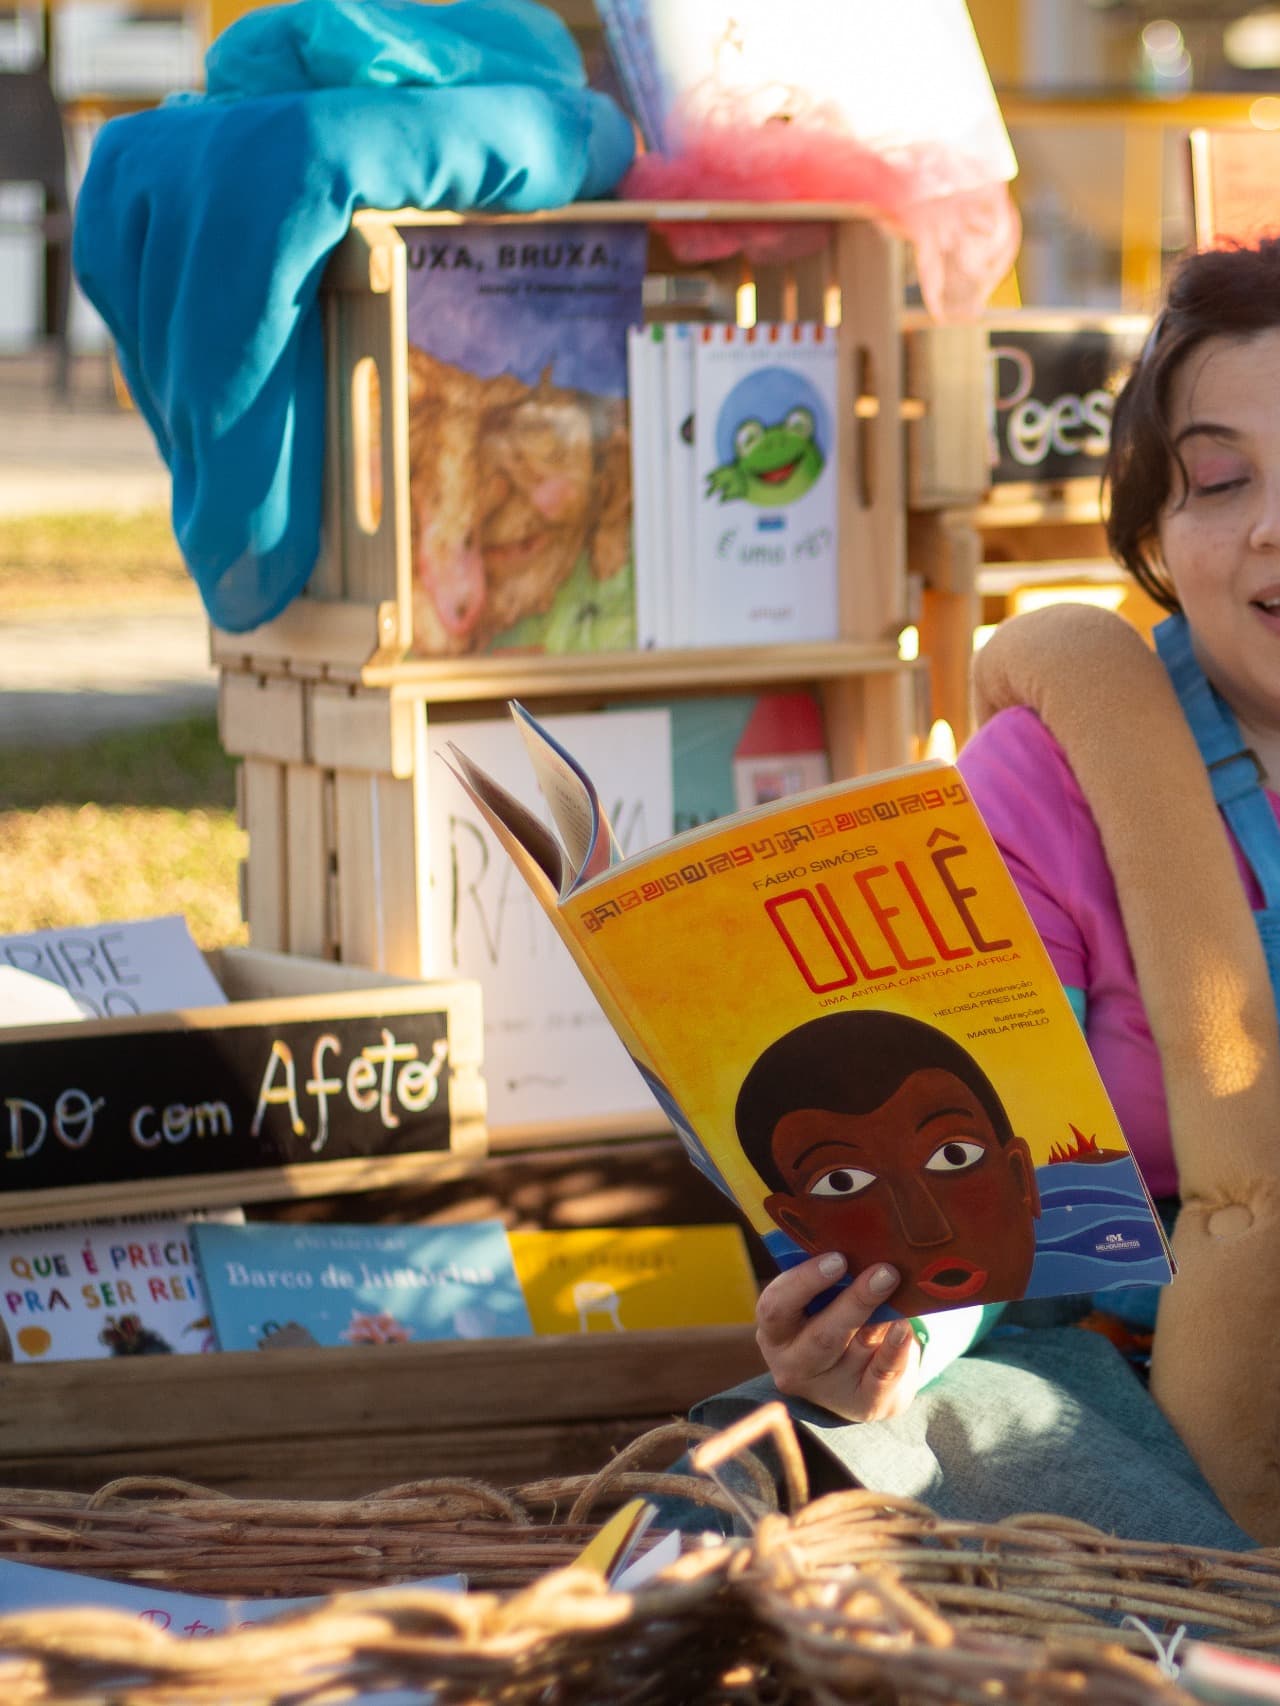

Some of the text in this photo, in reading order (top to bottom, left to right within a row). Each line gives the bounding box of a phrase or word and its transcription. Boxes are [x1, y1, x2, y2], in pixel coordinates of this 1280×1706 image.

[499, 242, 620, 268] BRUXA,
[753, 845, 879, 890] FÁBIO SIMÕES
[764, 827, 1013, 994] OLELÊ
[819, 994, 849, 1008] UMA
[851, 982, 897, 1000] ANTIGA
[899, 968, 952, 986] CANTIGA
[955, 963, 974, 975] DA
[968, 981, 1033, 998] Coordenação
[980, 995, 1010, 1007] PIRES
[1012, 990, 1038, 1001] LIMA
[994, 1008, 1046, 1022] Ilustrações
[1011, 1017, 1050, 1031] PIRILLO
[131, 1098, 233, 1149] com
[251, 1028, 448, 1153] Afeto
[10, 1254, 70, 1282] QUE
[80, 1238, 99, 1275] É
[224, 1262, 313, 1287] Barco
[320, 1263, 352, 1289] de
[5, 1276, 197, 1314] PRA SER REI
